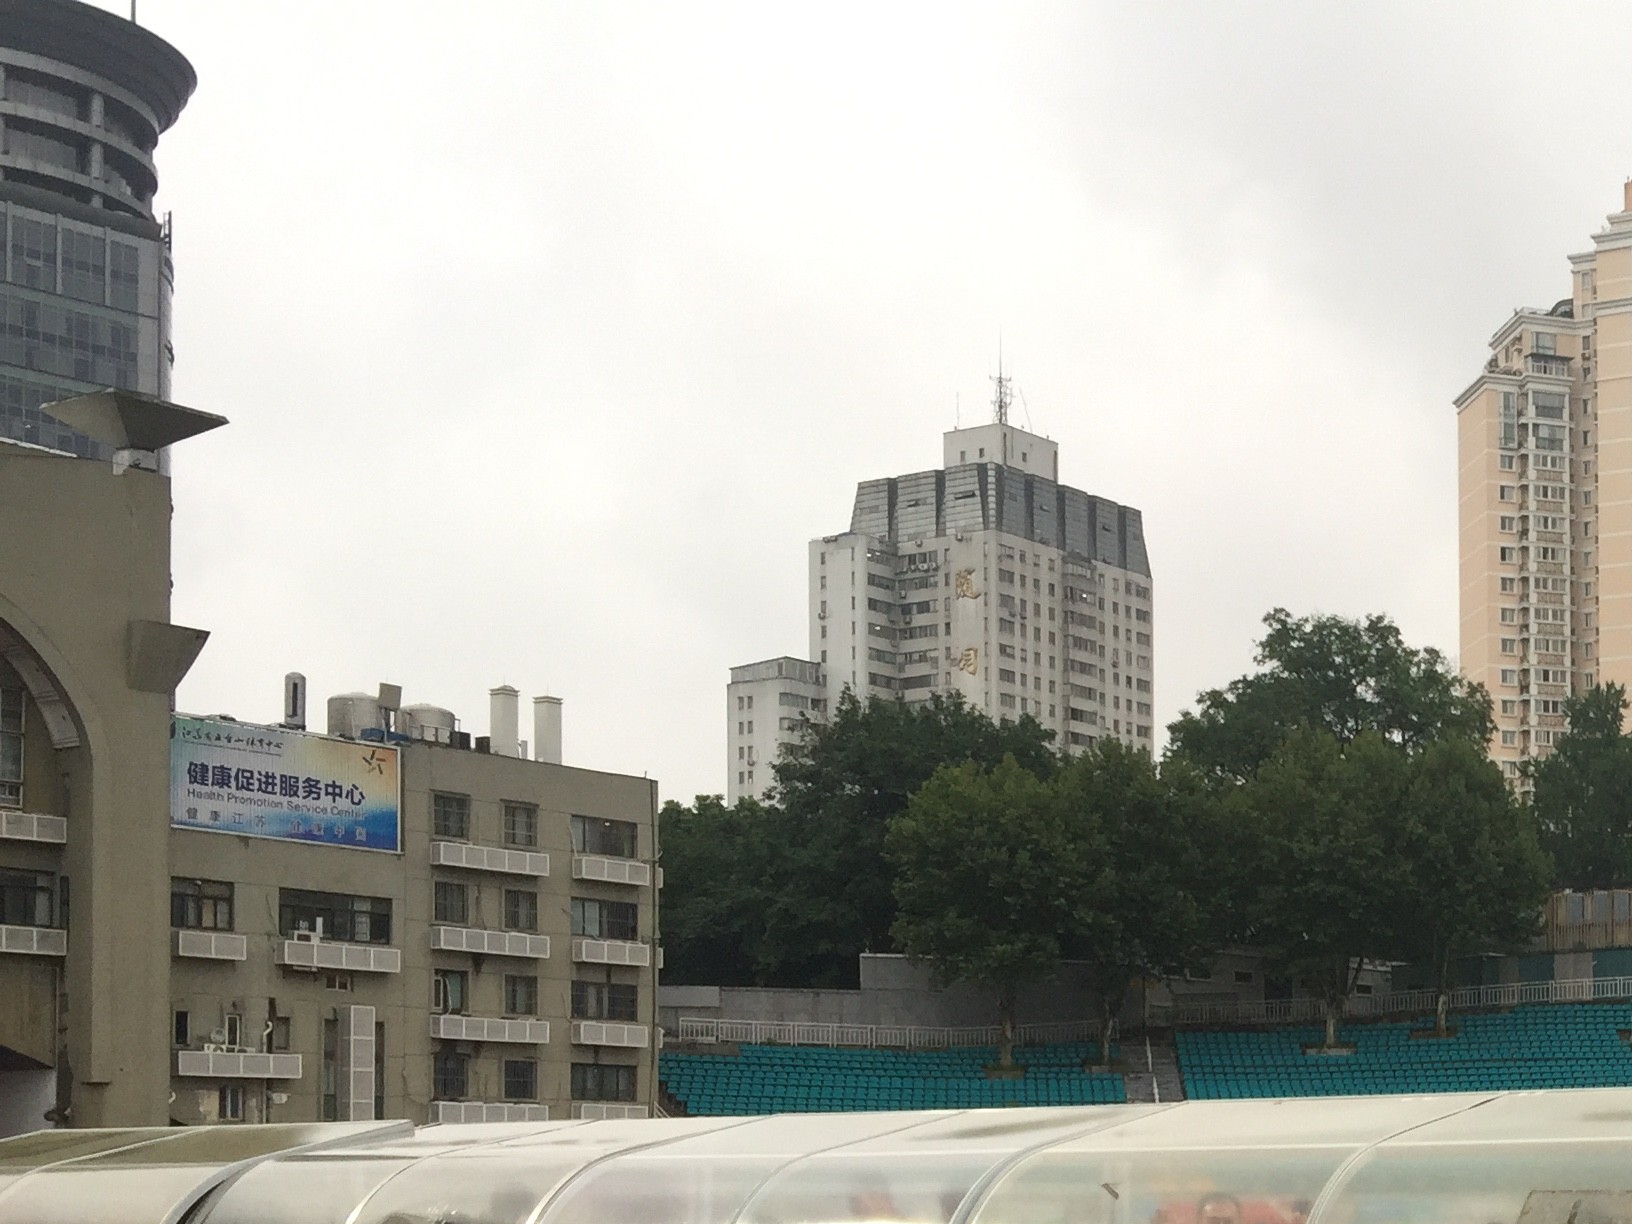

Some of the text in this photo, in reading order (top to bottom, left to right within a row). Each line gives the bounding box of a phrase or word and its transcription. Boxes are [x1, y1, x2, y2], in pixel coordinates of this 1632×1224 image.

[187, 761, 366, 806] 健康促进服务中心
[187, 788, 225, 802] Health
[227, 793, 283, 808] Promotion
[287, 800, 328, 815] Service
